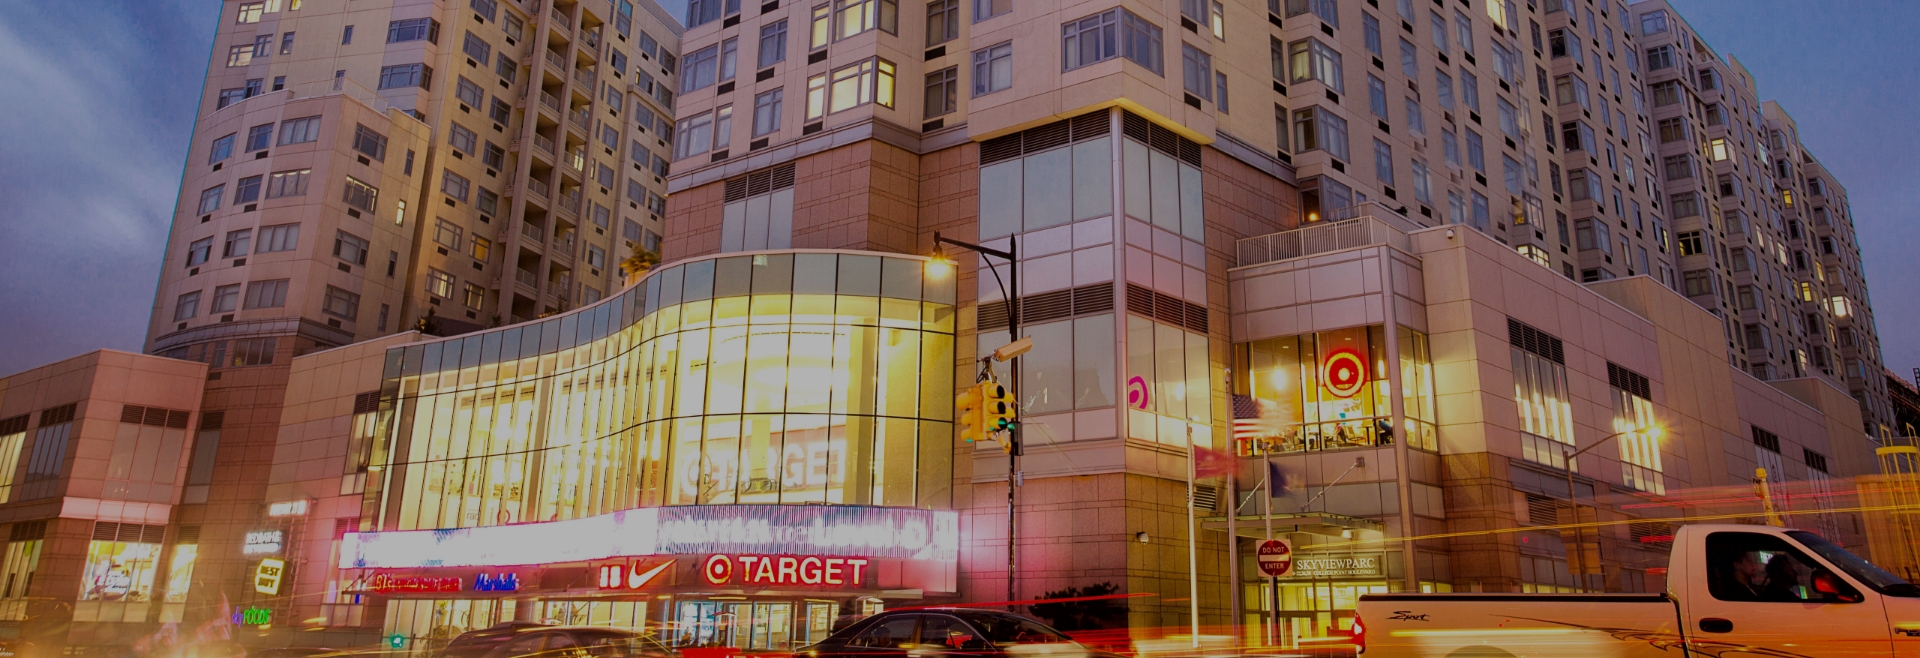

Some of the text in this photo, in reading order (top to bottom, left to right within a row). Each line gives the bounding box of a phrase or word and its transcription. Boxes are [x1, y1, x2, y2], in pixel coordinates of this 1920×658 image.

[739, 557, 867, 585] TARGET
[473, 573, 518, 591] Marshalls
[1385, 610, 1431, 622] Sport
